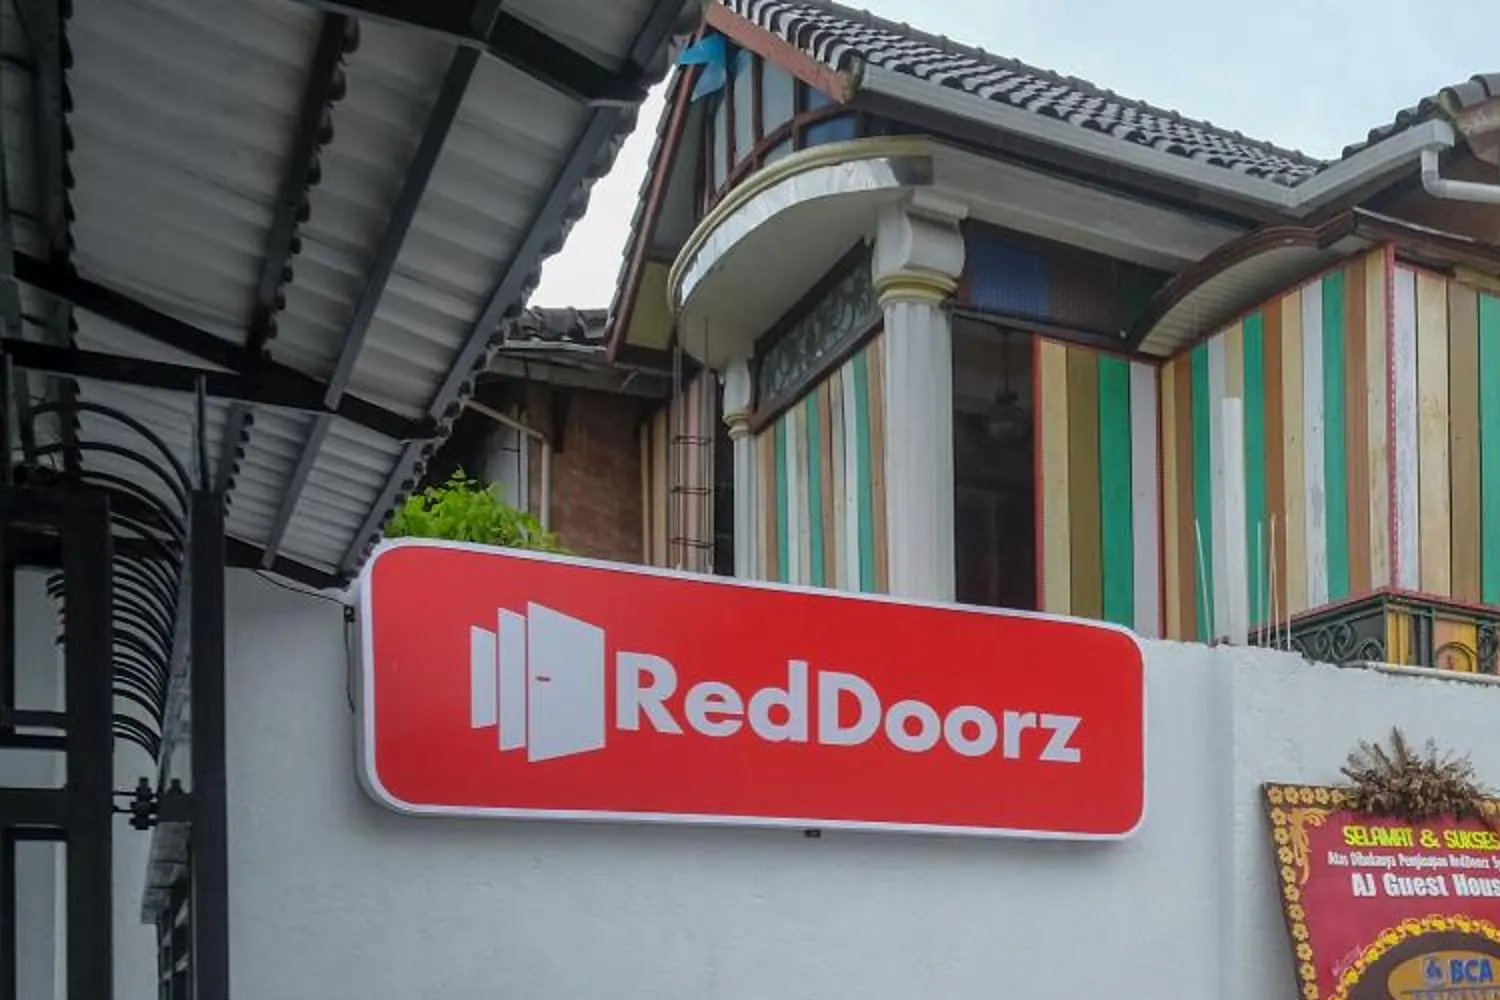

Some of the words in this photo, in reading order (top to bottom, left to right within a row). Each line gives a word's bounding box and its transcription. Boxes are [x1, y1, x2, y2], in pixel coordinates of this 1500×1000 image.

[615, 651, 1081, 763] RedDoorz
[1343, 825, 1414, 848] SELAMAT
[1420, 829, 1441, 849] &
[1383, 873, 1449, 897] Guest
[1450, 959, 1494, 983] BCA
